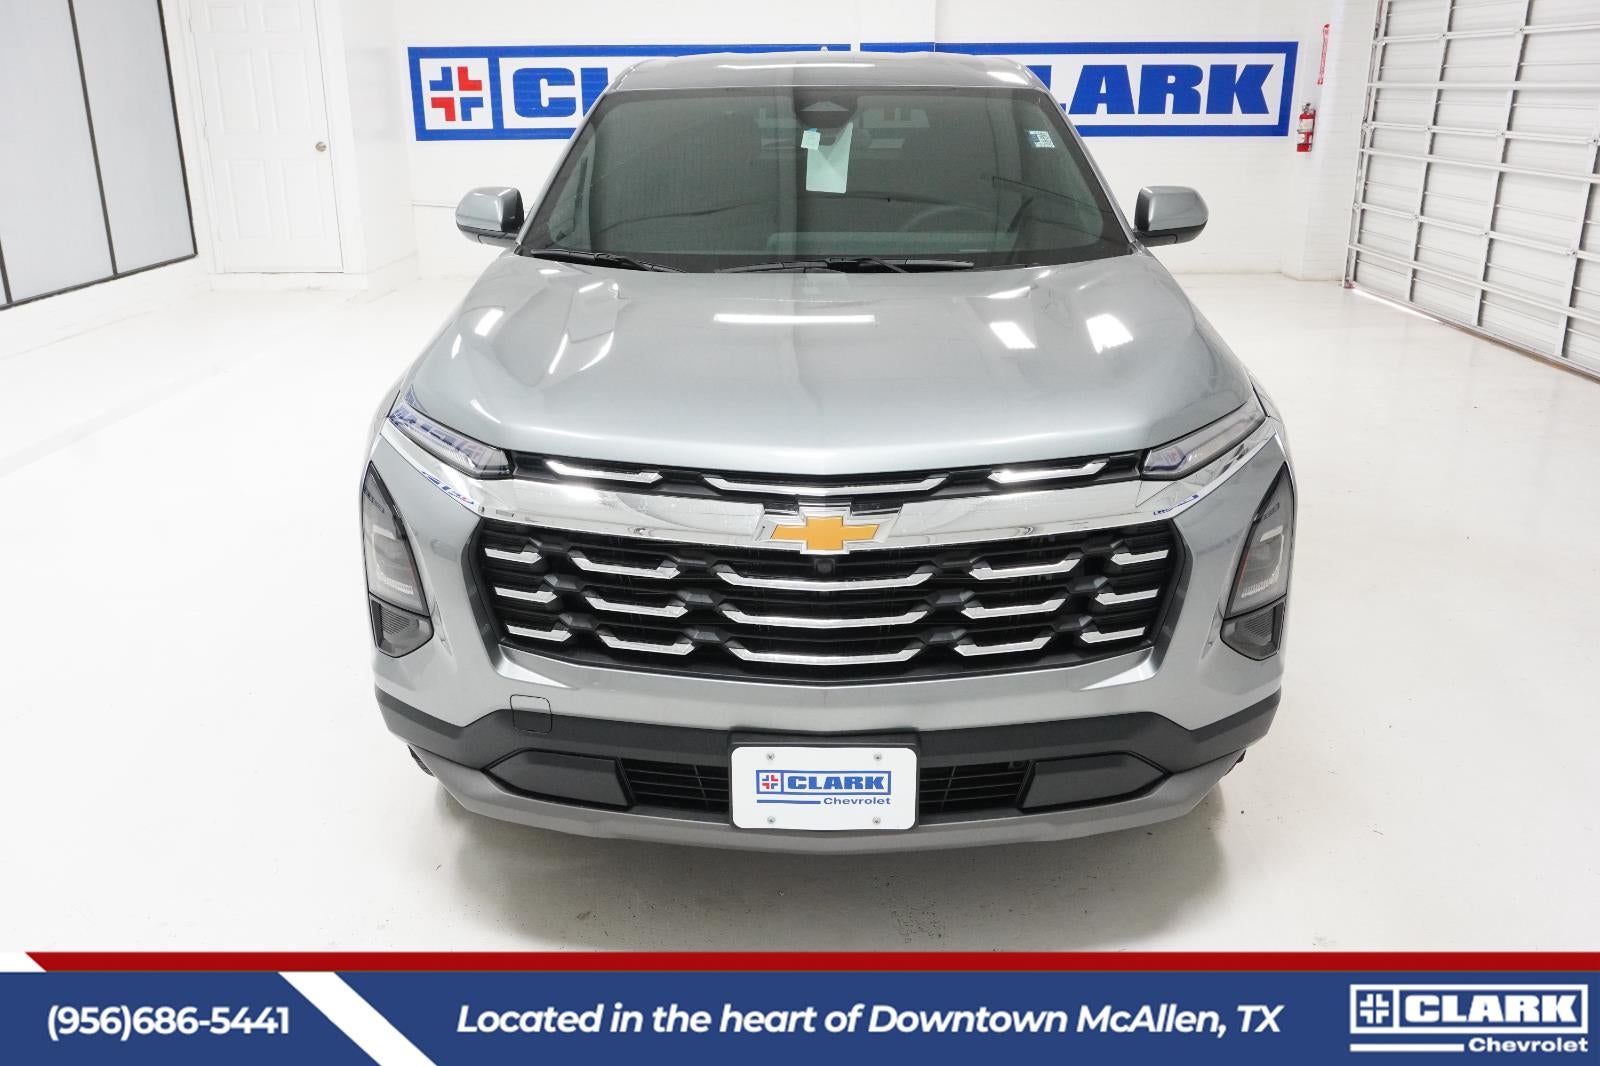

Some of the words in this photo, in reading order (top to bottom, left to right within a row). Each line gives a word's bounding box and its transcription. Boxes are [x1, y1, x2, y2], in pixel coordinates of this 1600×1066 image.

[1025, 64, 1275, 115] ARK
[787, 776, 885, 790] CLARK
[823, 797, 891, 805] Chevrolet
